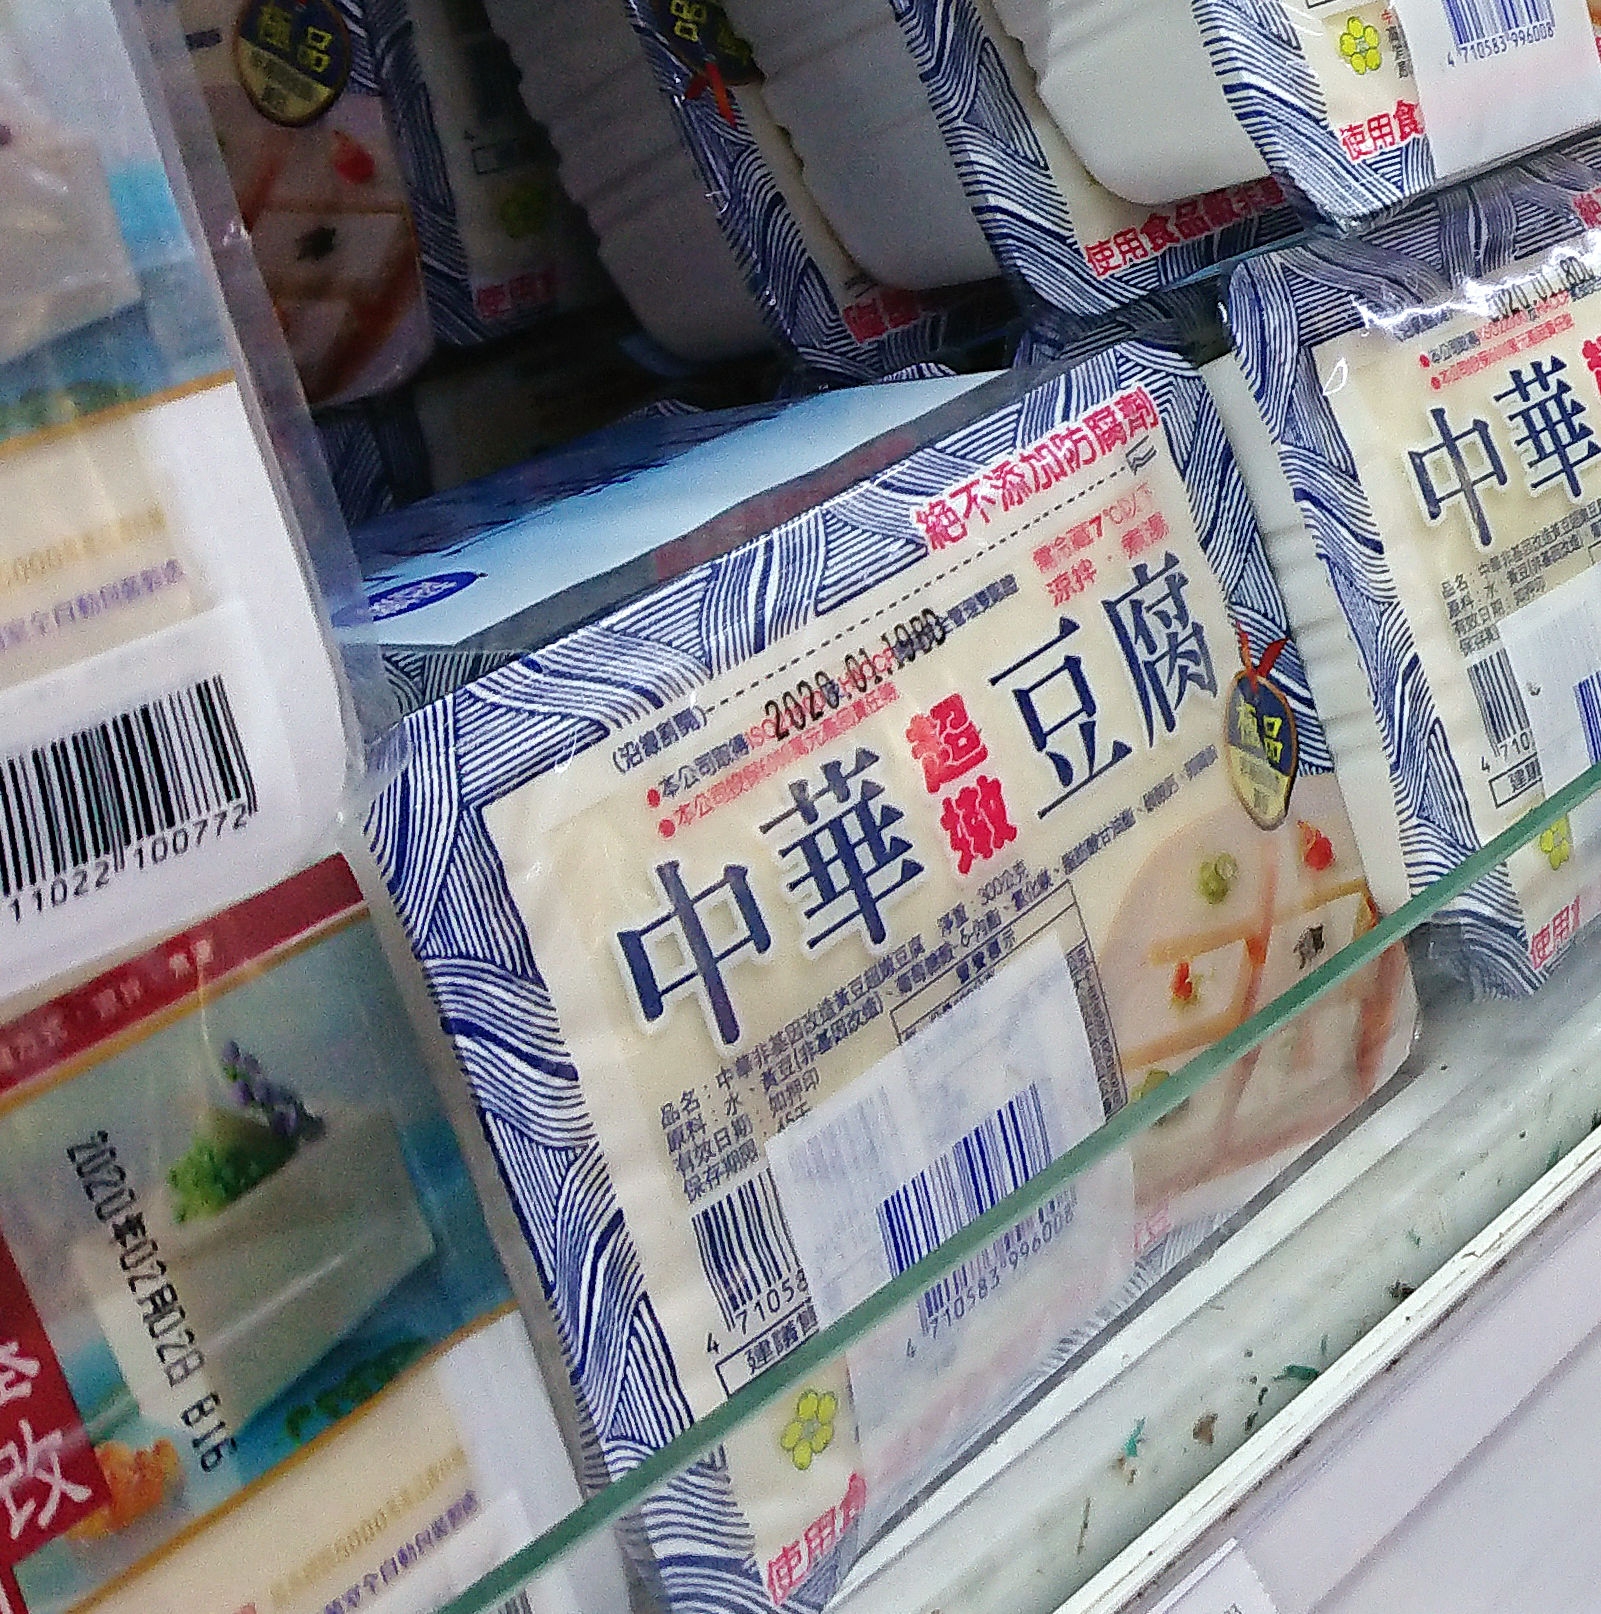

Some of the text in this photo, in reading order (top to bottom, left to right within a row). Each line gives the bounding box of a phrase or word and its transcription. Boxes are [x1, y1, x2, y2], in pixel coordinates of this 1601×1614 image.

[134, 803, 248, 872] 100772
[616, 549, 1219, 1045] 中華 超嫩 豆腐
